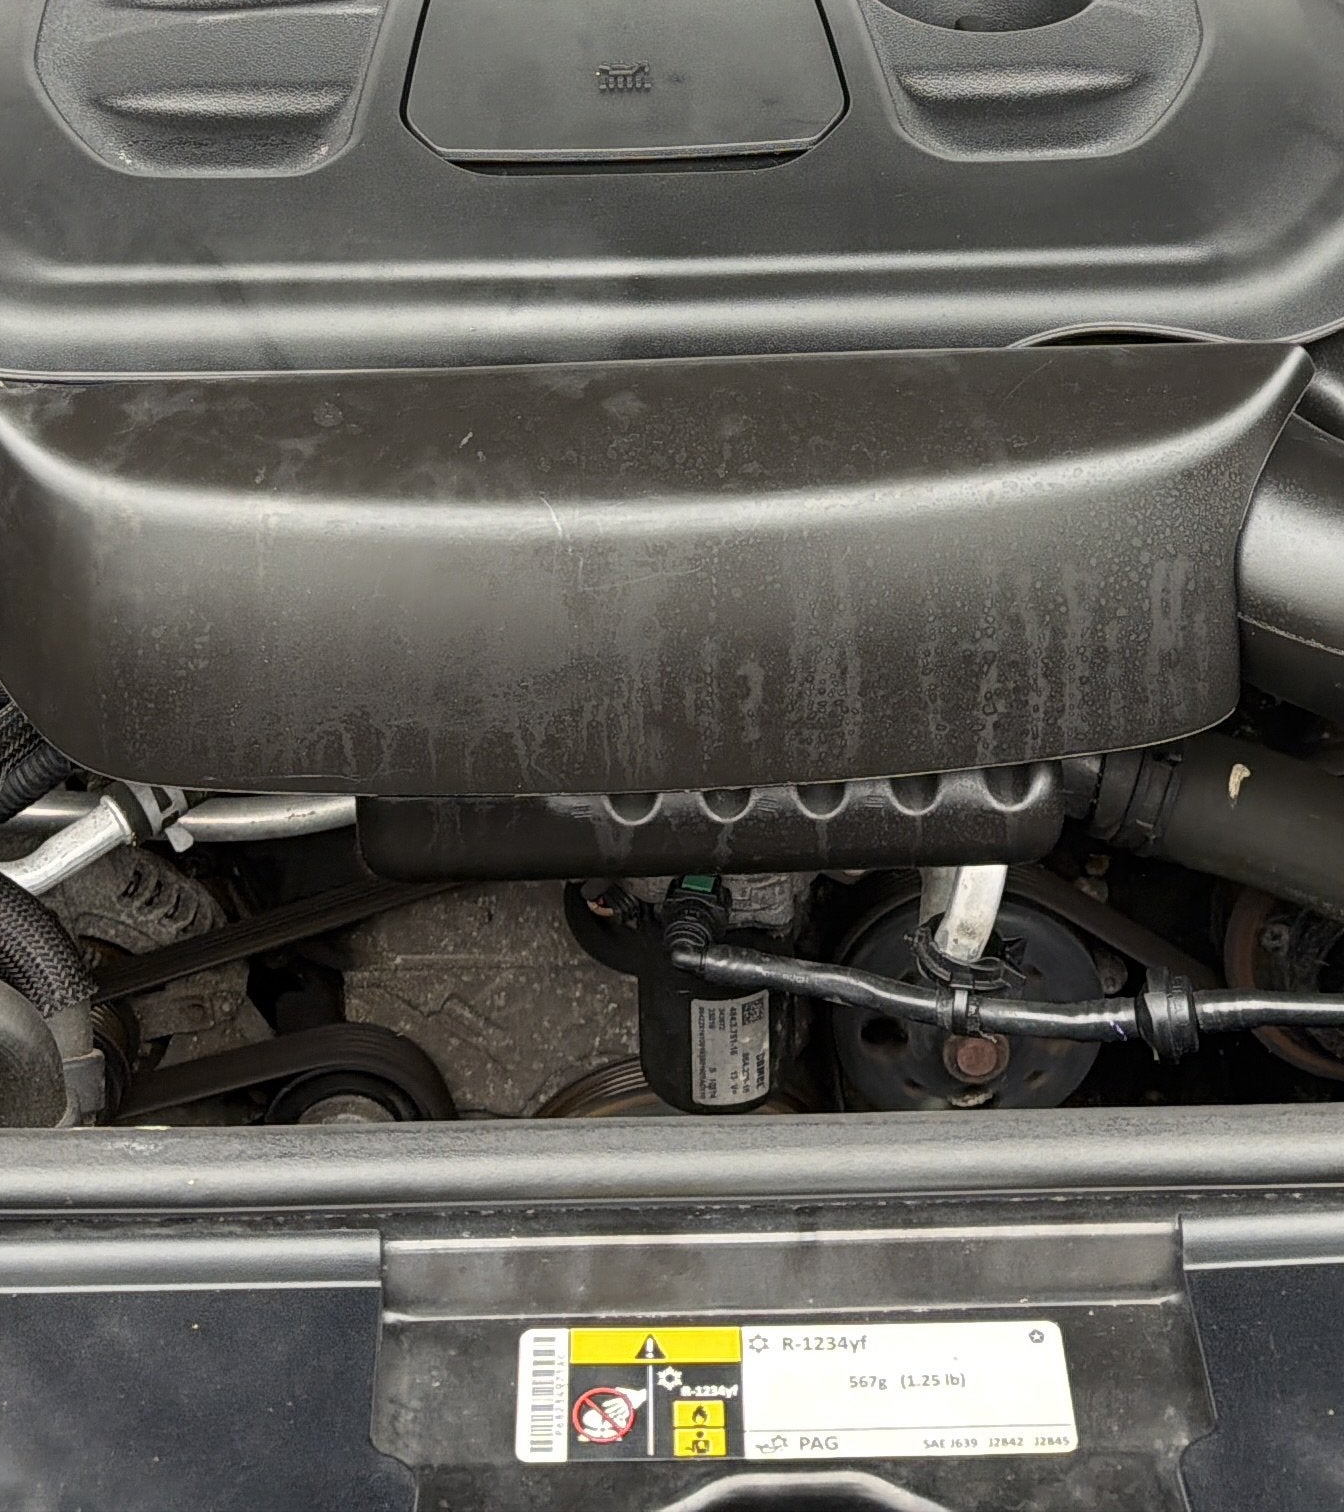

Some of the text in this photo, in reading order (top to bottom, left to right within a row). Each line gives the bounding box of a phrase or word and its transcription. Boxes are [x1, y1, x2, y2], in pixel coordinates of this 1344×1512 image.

[782, 1335, 867, 1353] R-1234yf
[849, 1373, 966, 1391] 567g (1.25 lb)
[680, 1384, 739, 1399] R-1234yf
[799, 1436, 839, 1451] PAG
[923, 1439, 945, 1449] SAE
[950, 1438, 978, 1448] J639
[989, 1437, 1024, 1448] J2842
